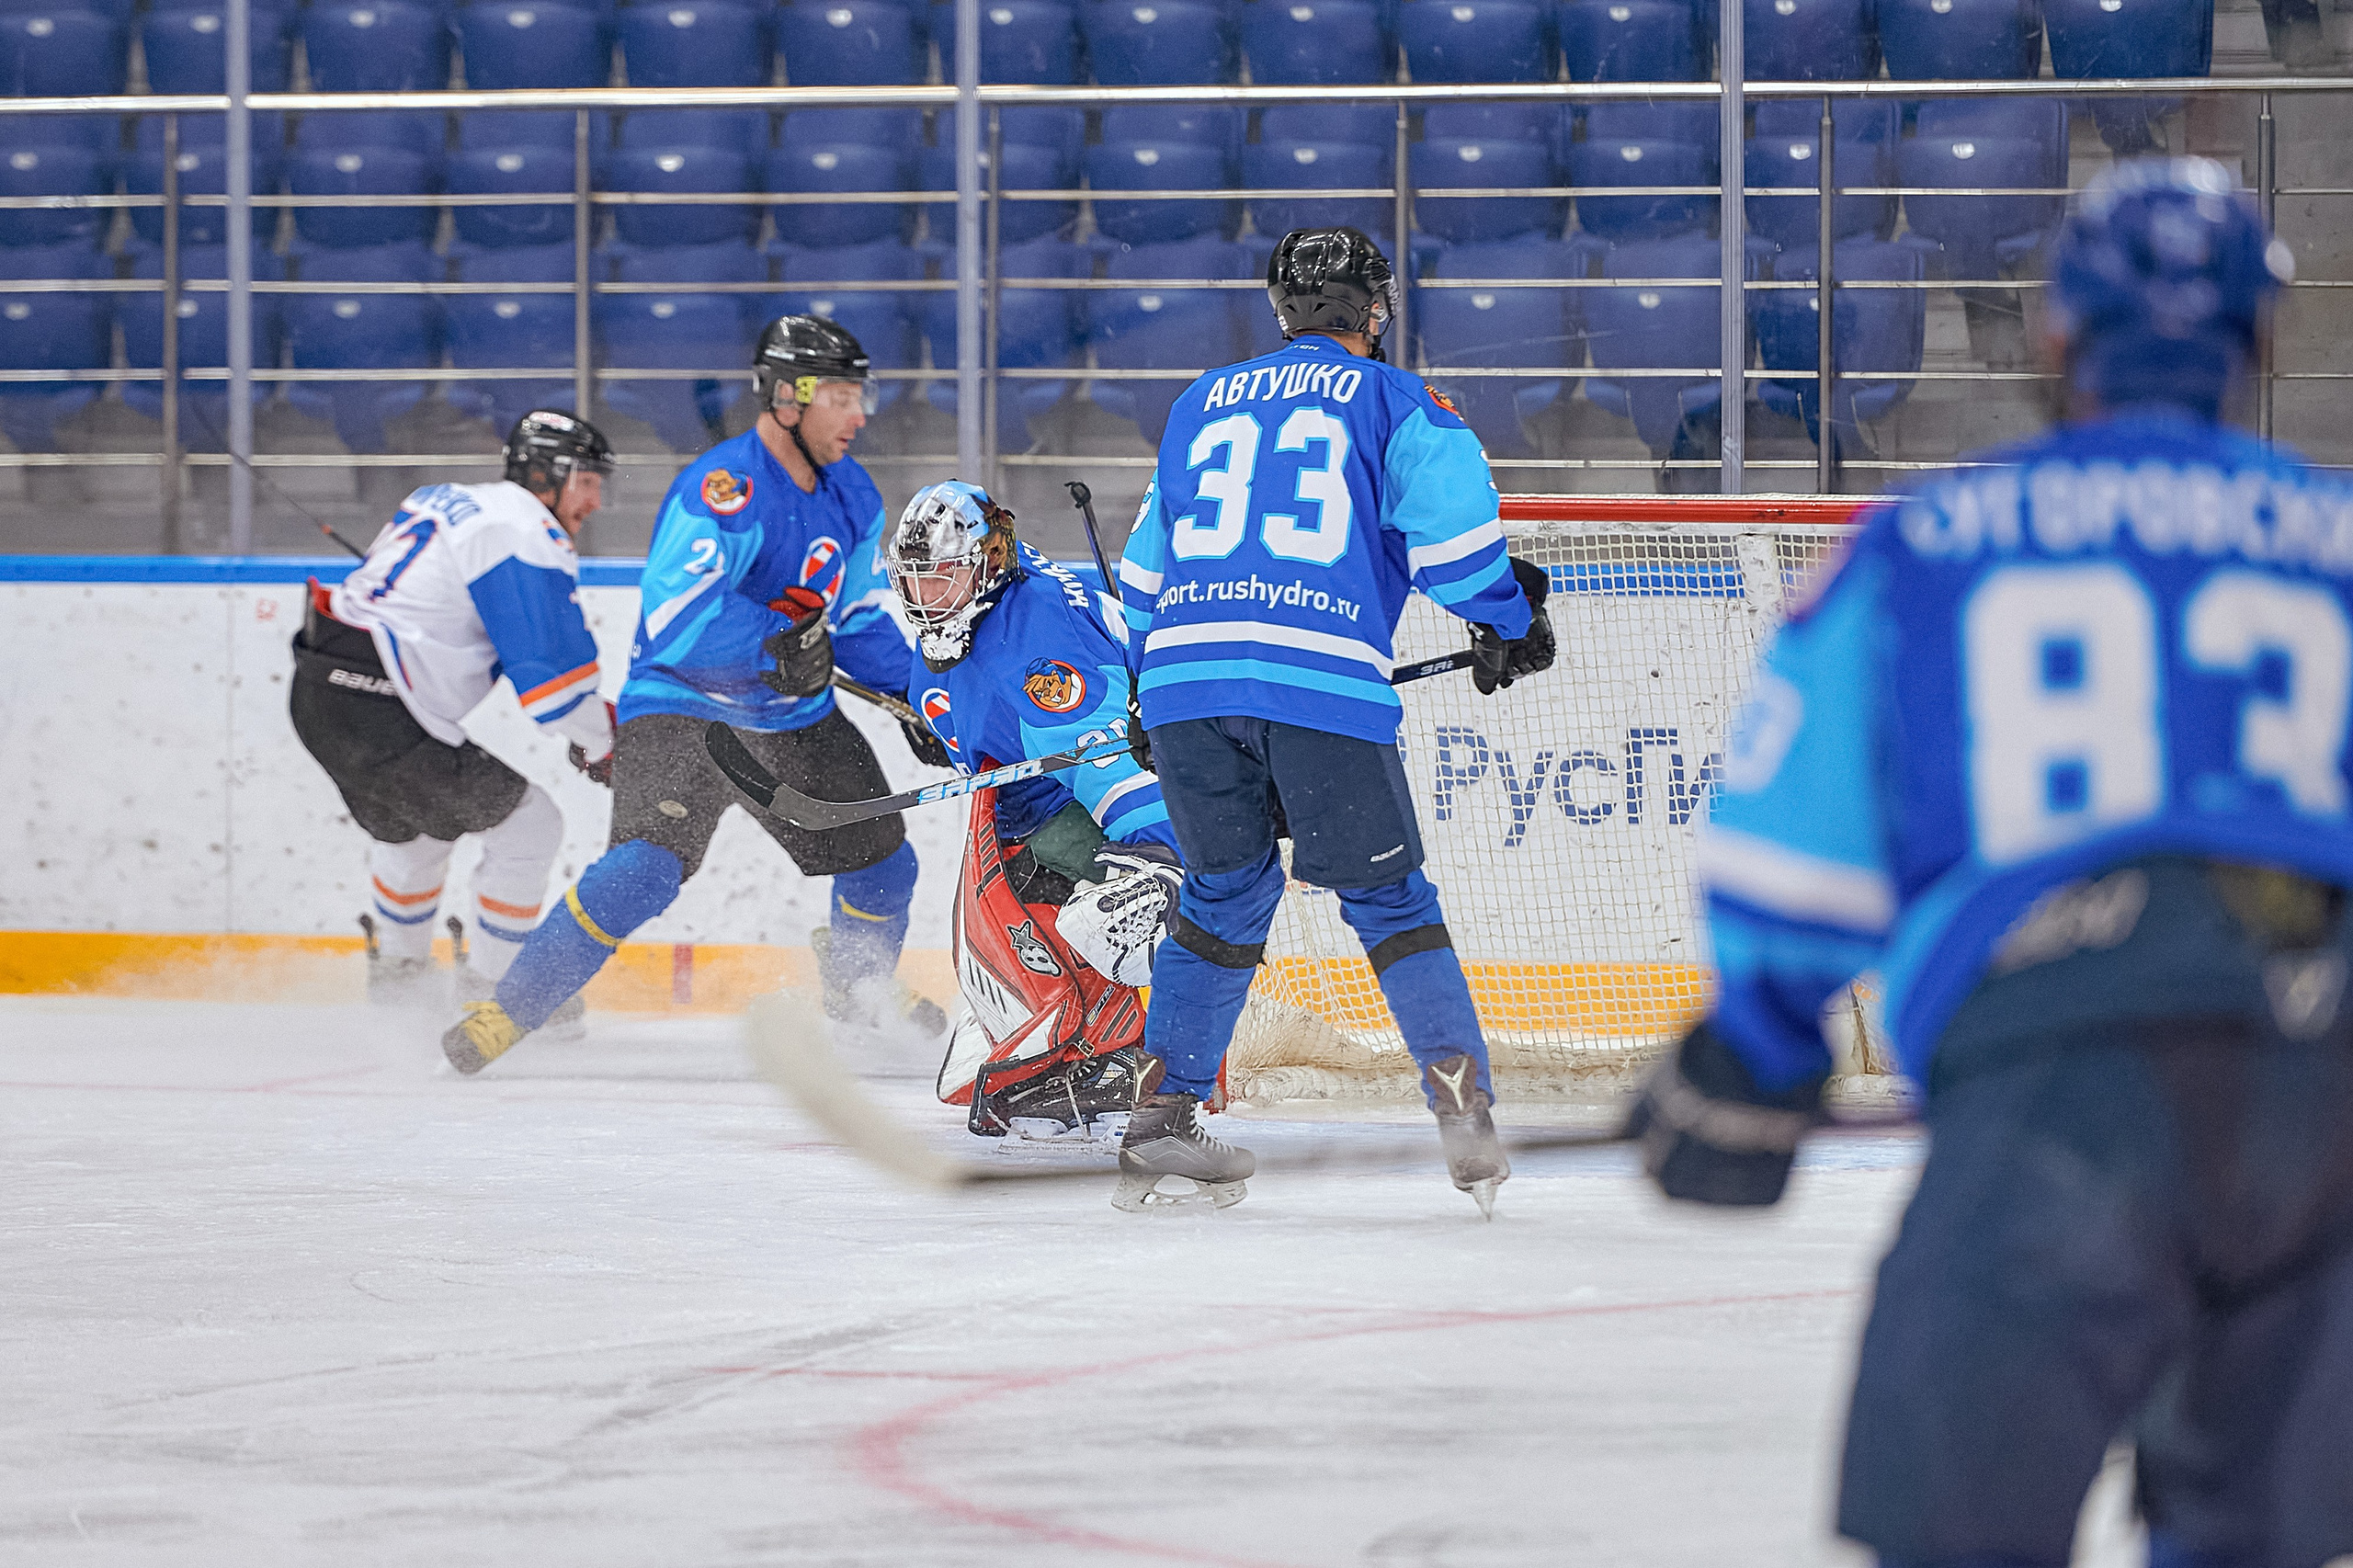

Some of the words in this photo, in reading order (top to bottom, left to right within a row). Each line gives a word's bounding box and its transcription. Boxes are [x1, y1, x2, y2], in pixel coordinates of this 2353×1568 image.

[1202, 361, 1362, 413] АВТУШКО
[1170, 405, 1354, 568] 33
[1155, 574, 1361, 622] port.rushydro.ru
[327, 668, 400, 696] BAUE
[1963, 561, 2353, 866] 83
